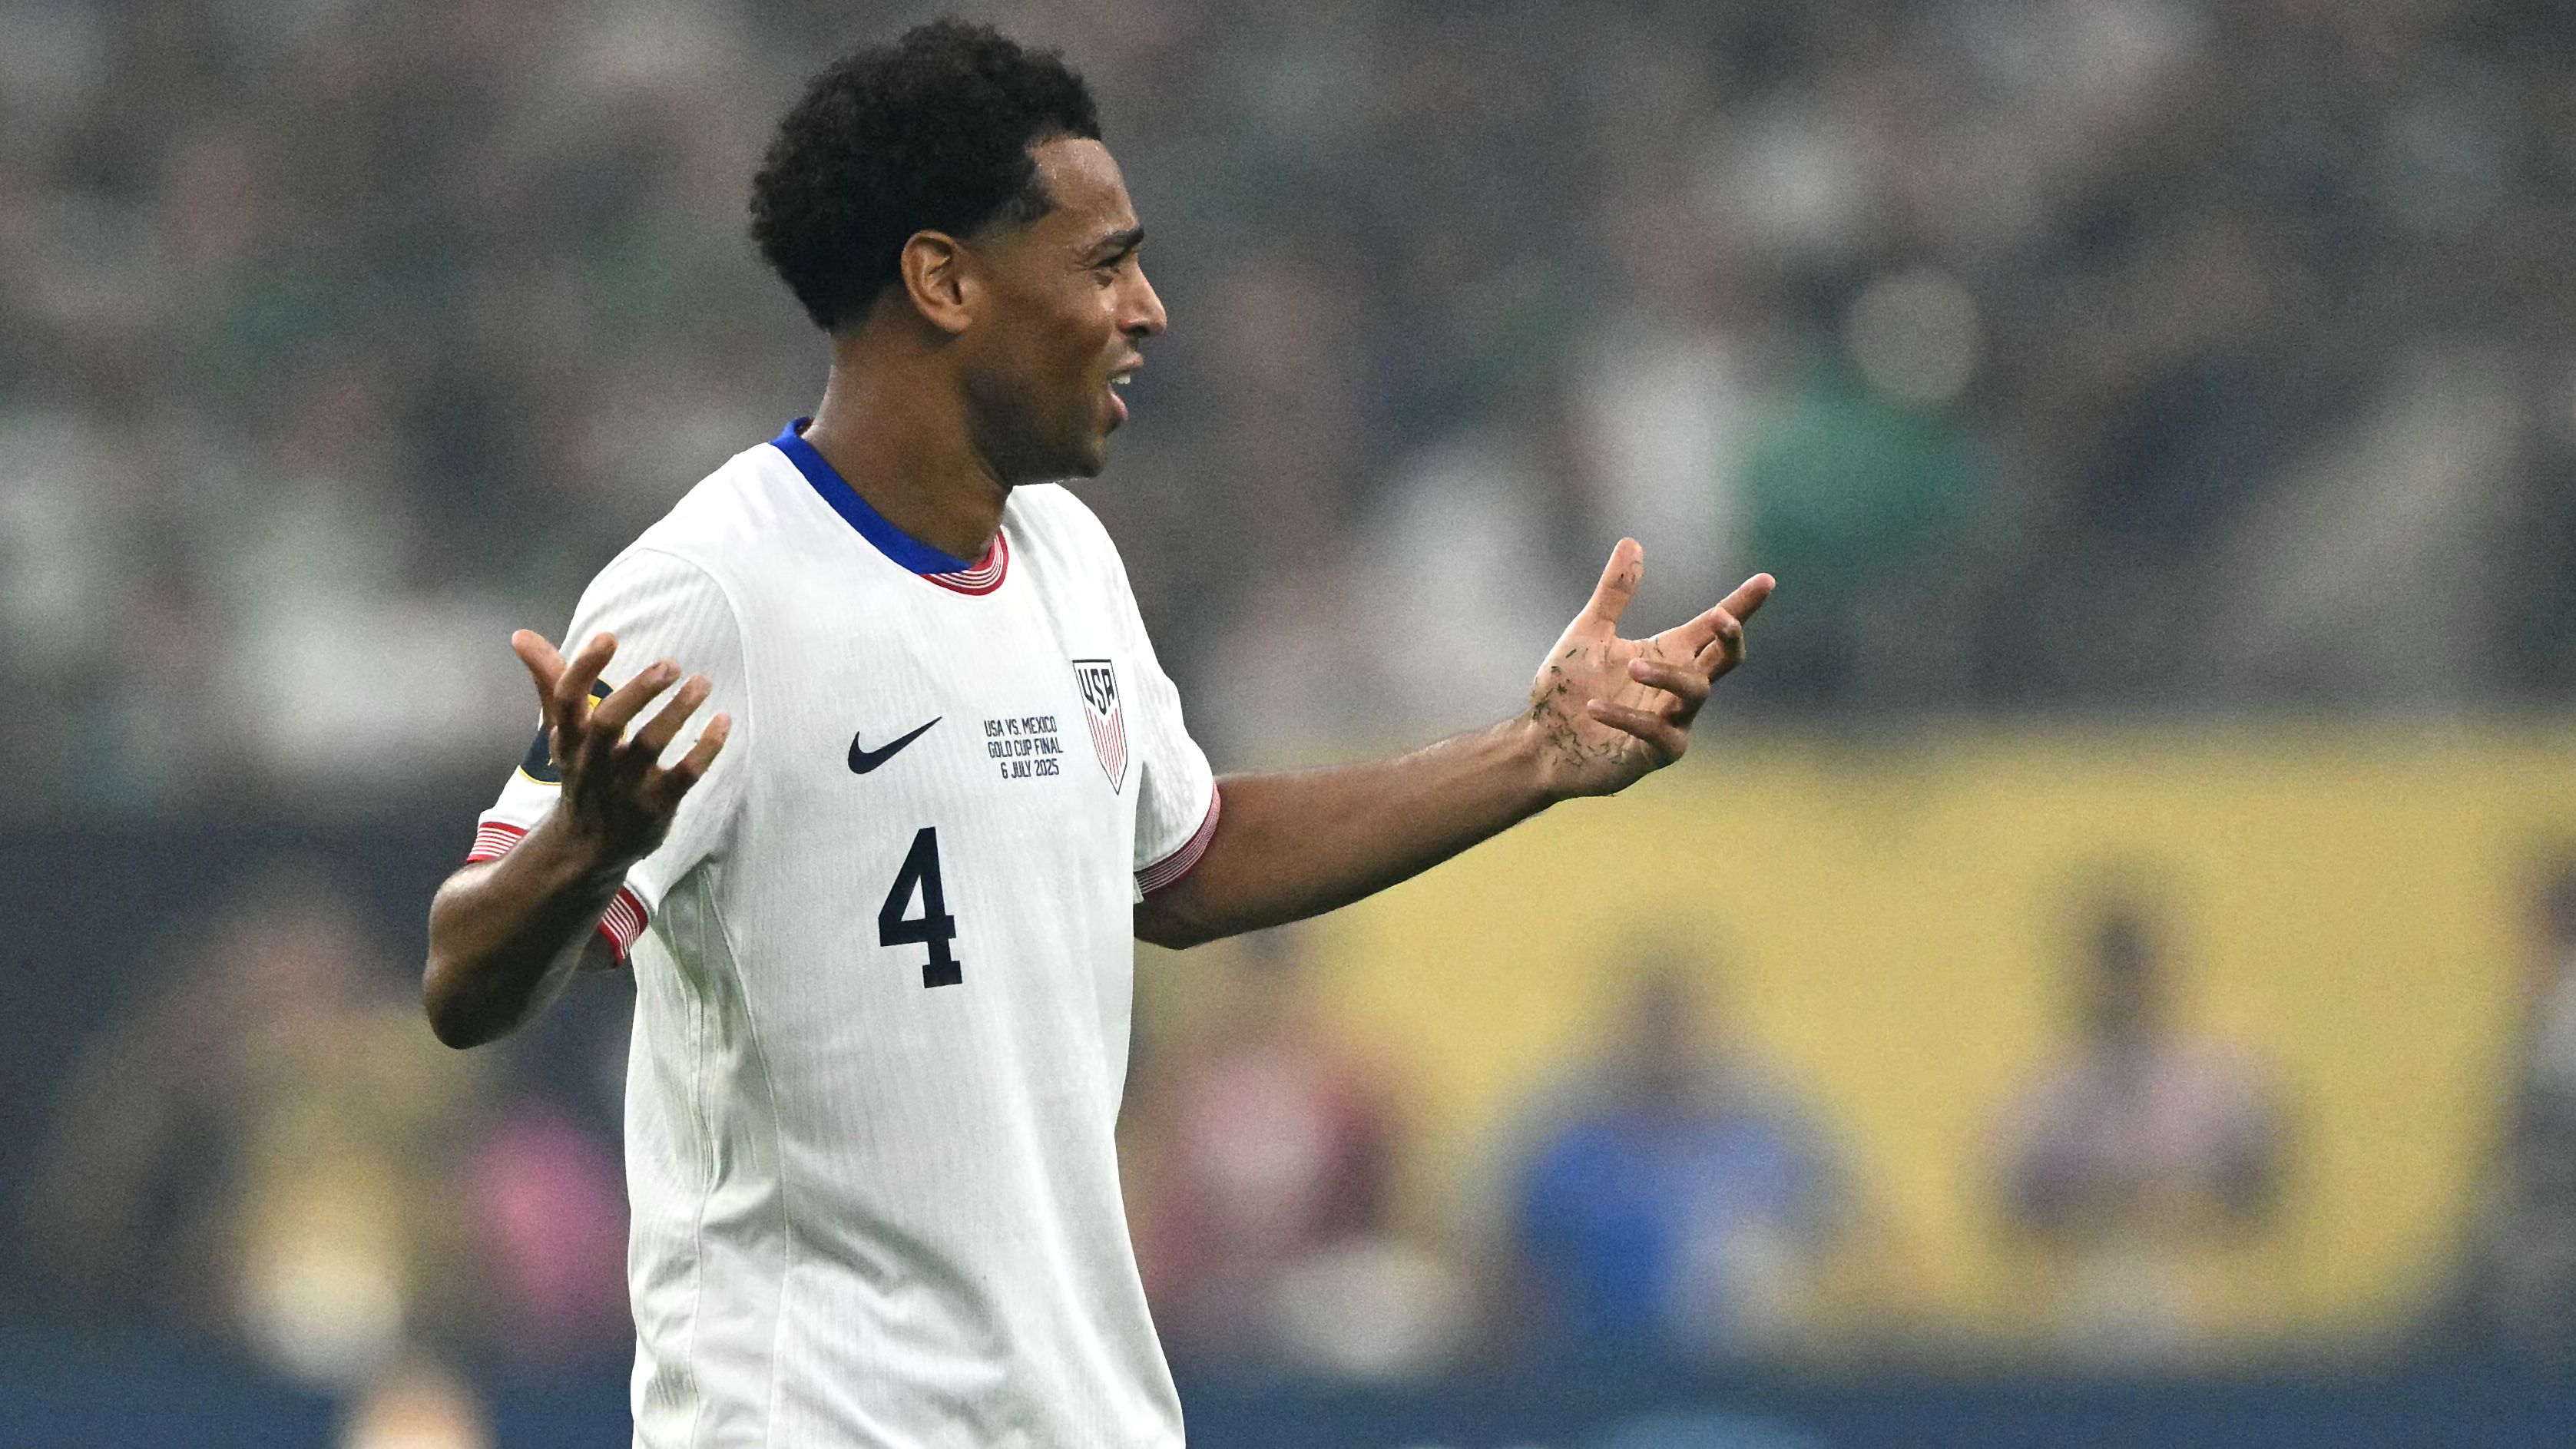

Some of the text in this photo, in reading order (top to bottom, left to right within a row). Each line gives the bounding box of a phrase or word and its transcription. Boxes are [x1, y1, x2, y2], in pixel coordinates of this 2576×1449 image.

[1078, 668, 1114, 716] USA
[984, 716, 1058, 737] USA VS. MEXICO
[988, 737, 1064, 758] GOLD CUP FINAL
[1000, 758, 1060, 779] 6 JULY 2025
[878, 826, 962, 988] 4
